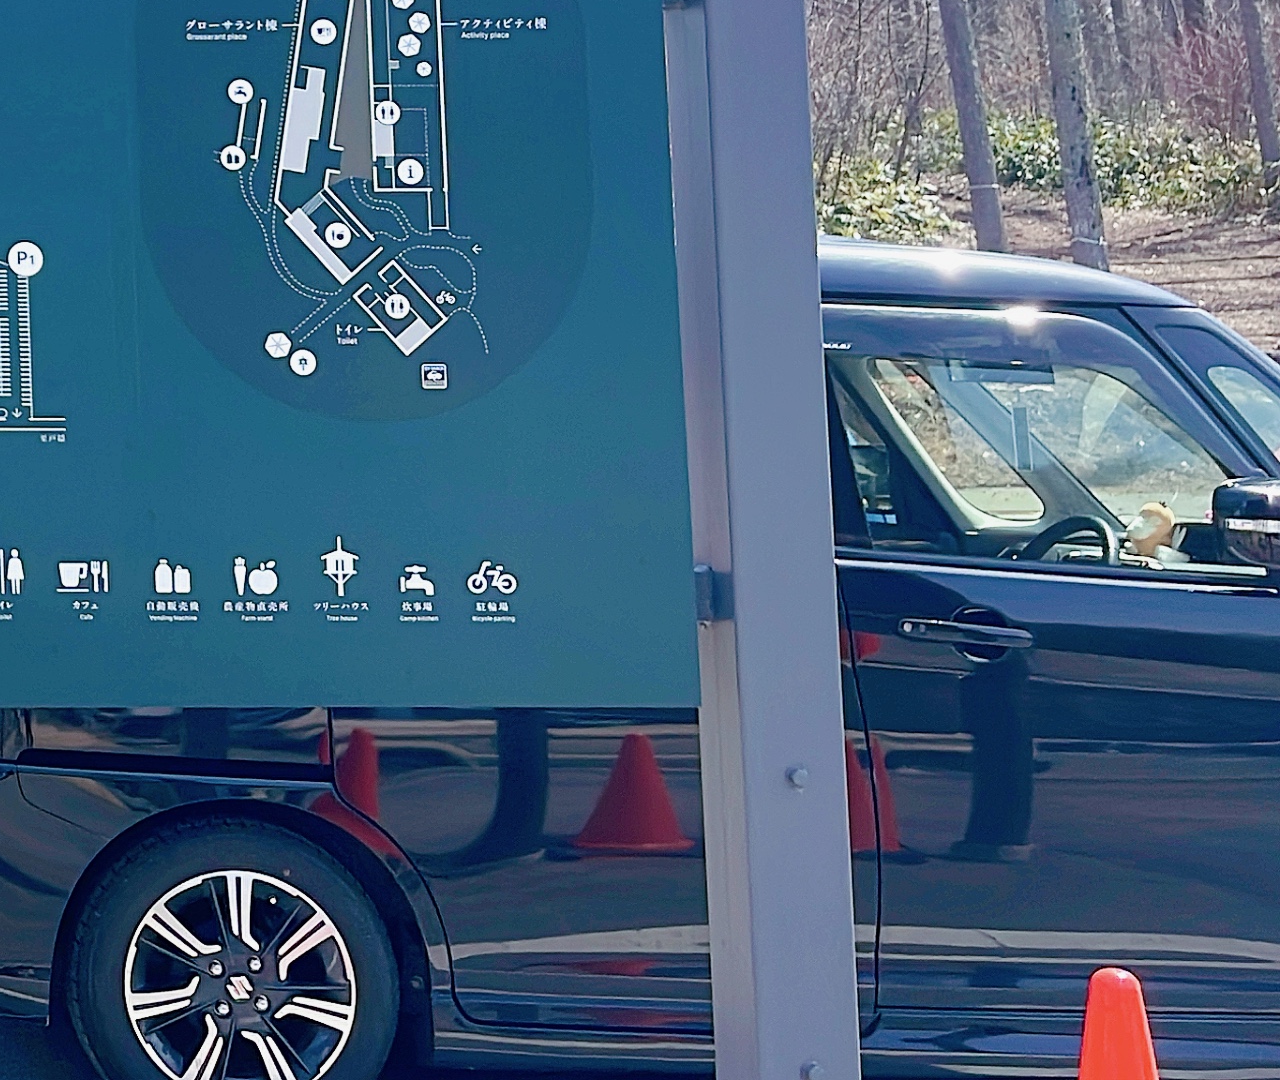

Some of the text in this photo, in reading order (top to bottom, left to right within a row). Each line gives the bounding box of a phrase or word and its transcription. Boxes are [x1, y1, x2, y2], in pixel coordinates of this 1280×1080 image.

[460, 18, 546, 29] アクティビティ棟
[461, 32, 488, 40] Activity
[337, 324, 363, 335] トイレ
[72, 600, 99, 610] カフェ
[146, 601, 200, 612] 自動販売機
[223, 601, 289, 612] 農産物直売所
[313, 601, 369, 612] ツリーハウス
[402, 601, 433, 612] 炊事場
